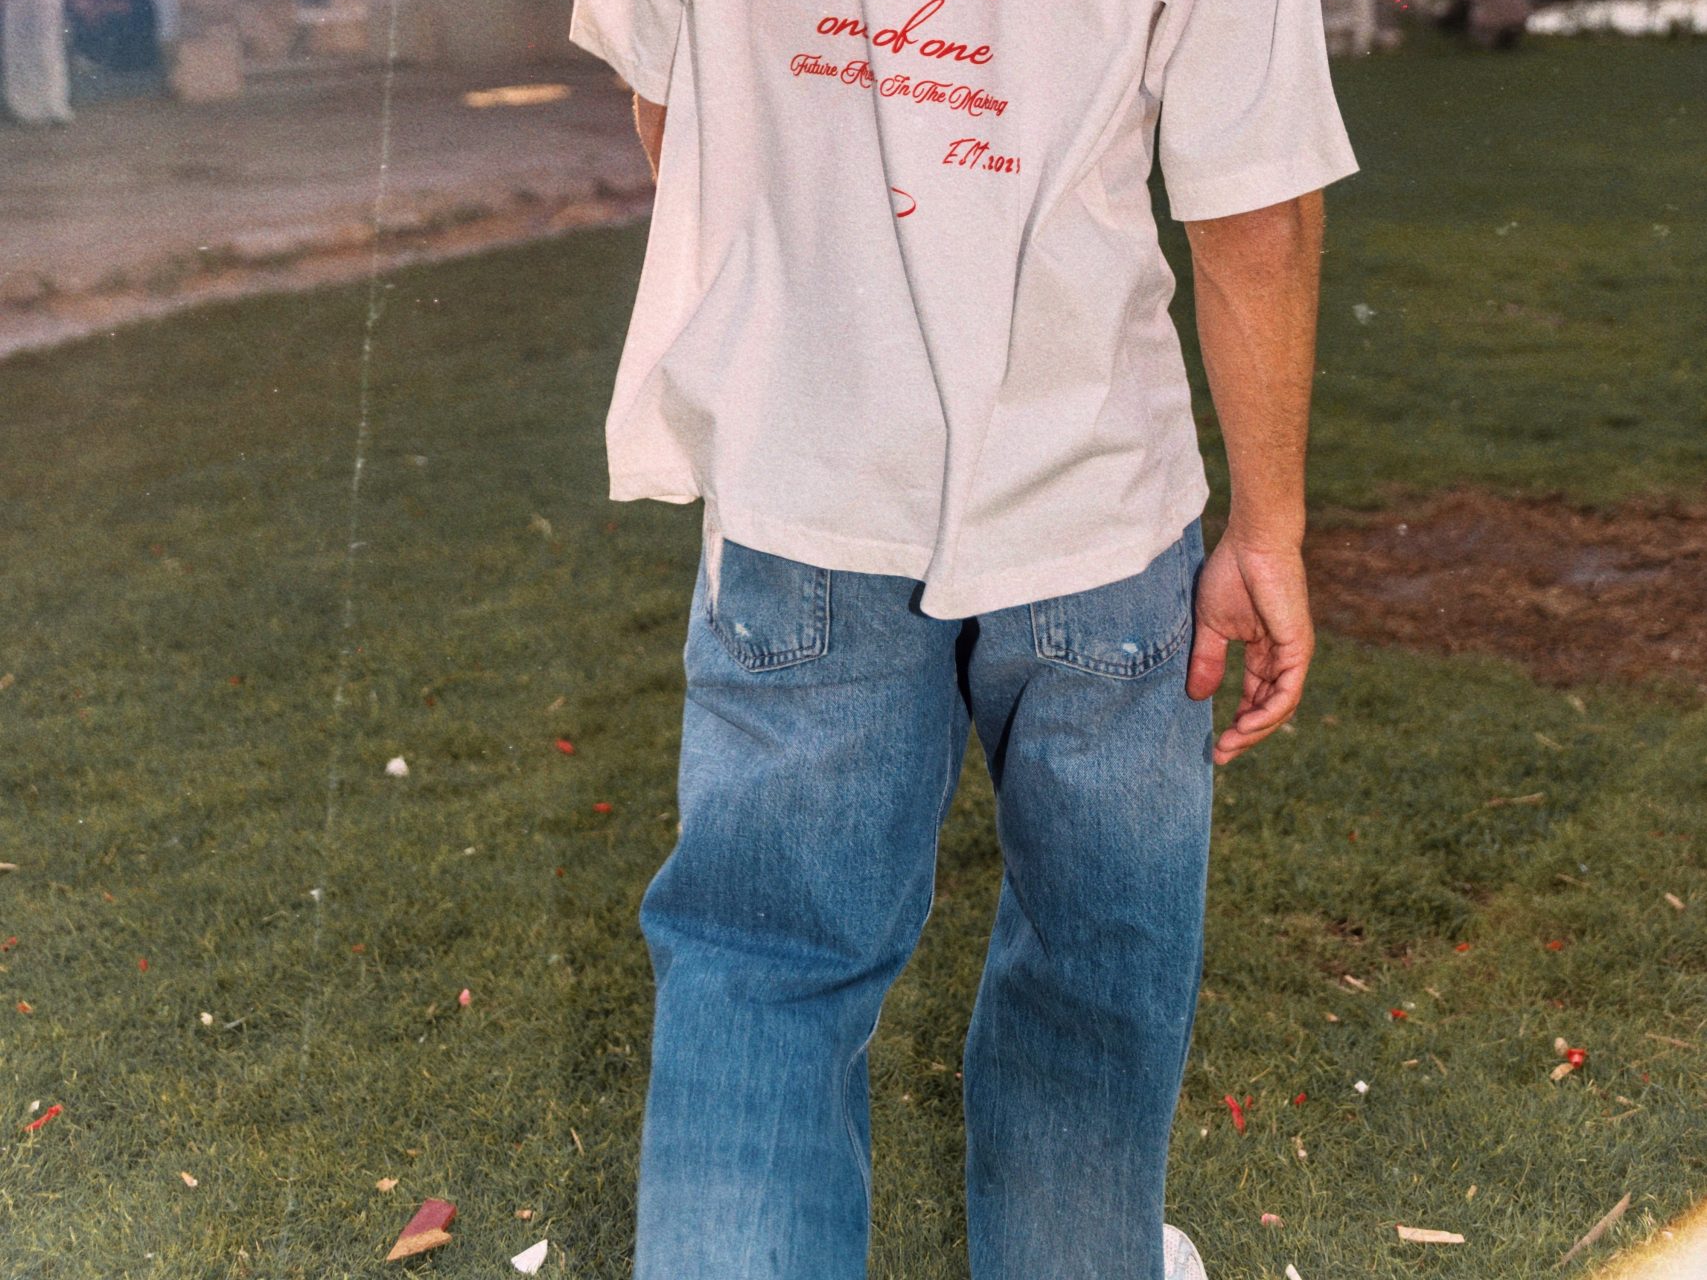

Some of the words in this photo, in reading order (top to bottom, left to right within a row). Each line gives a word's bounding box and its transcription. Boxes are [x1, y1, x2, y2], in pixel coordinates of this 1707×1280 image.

[918, 38, 993, 66] one
[790, 53, 838, 77] Future
[879, 74, 911, 98] In
[912, 80, 954, 104] The
[948, 85, 1009, 117] Making
